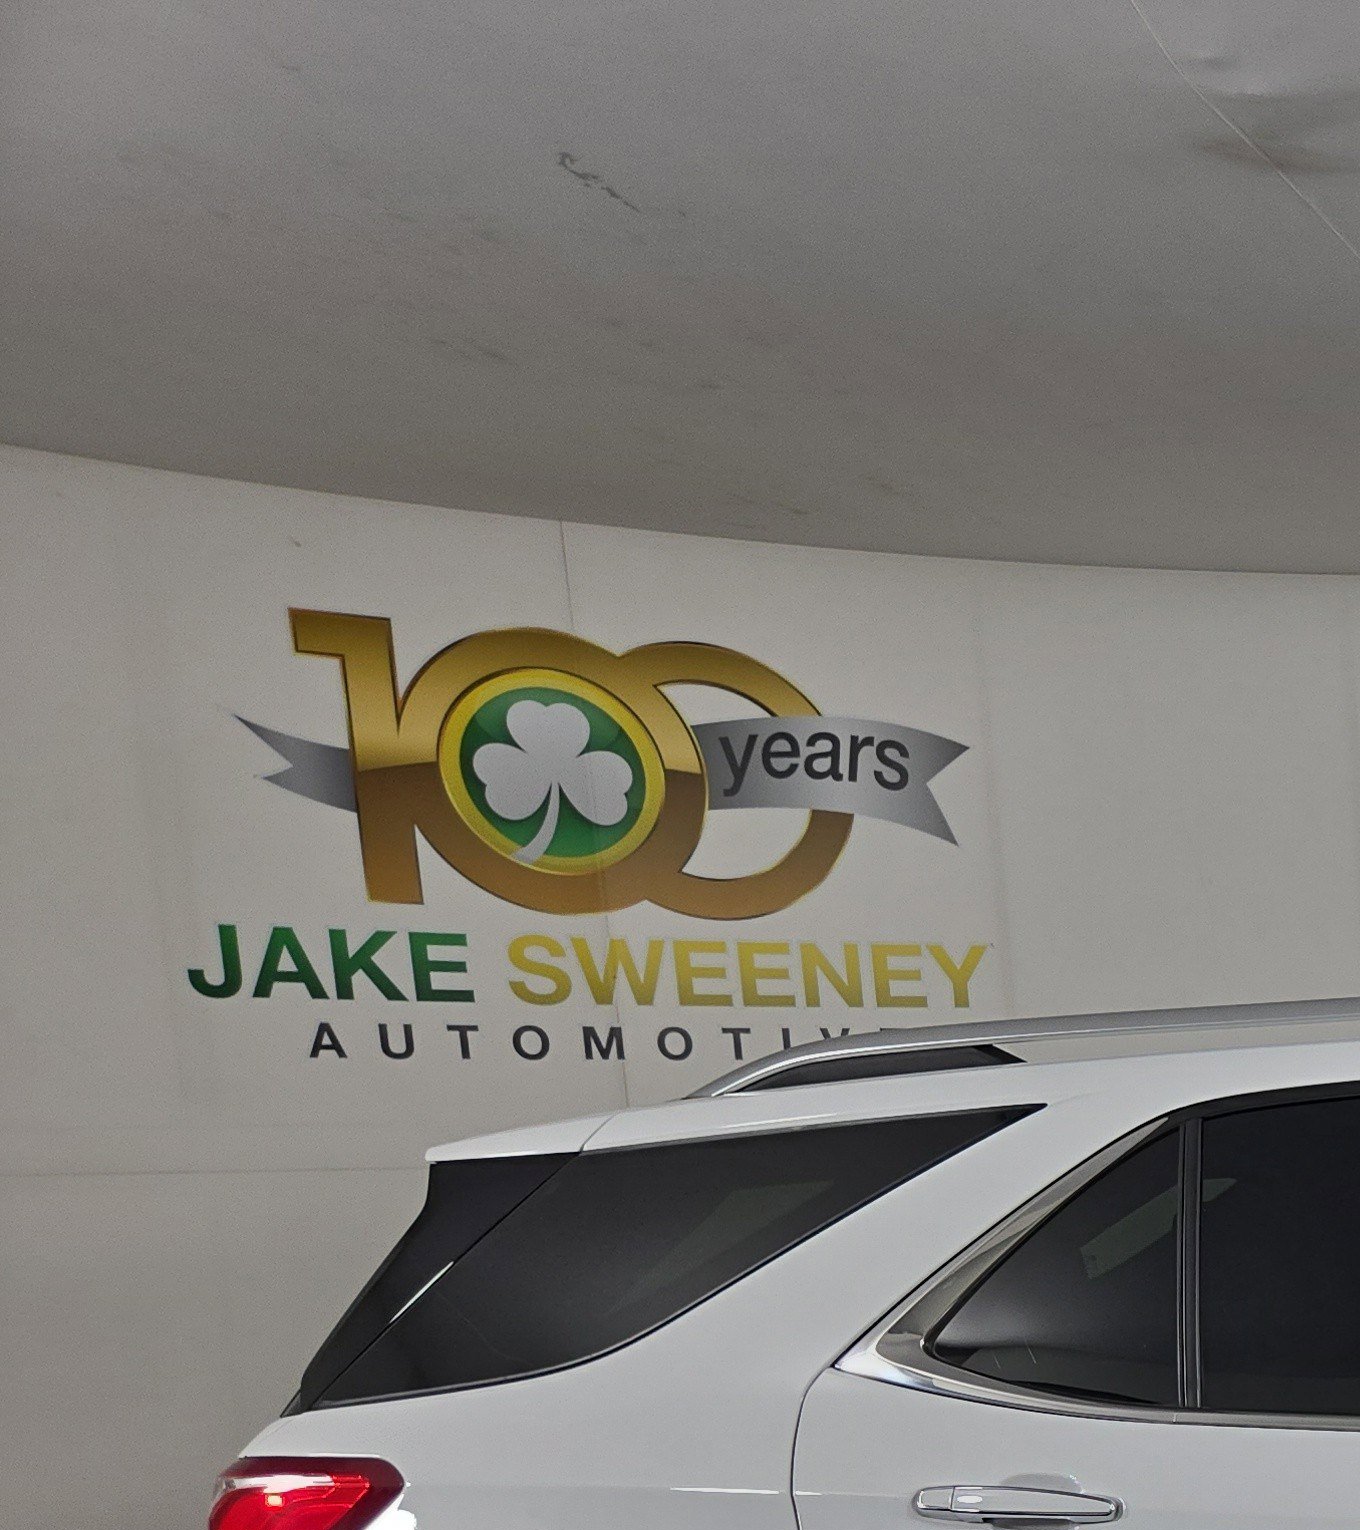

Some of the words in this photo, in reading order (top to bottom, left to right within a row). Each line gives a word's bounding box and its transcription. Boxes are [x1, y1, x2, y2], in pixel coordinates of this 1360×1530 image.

[718, 731, 911, 796] years
[187, 924, 476, 1002] JAKE
[507, 935, 988, 1009] SWEENEY
[309, 1021, 908, 1061] AUTOMOTI
